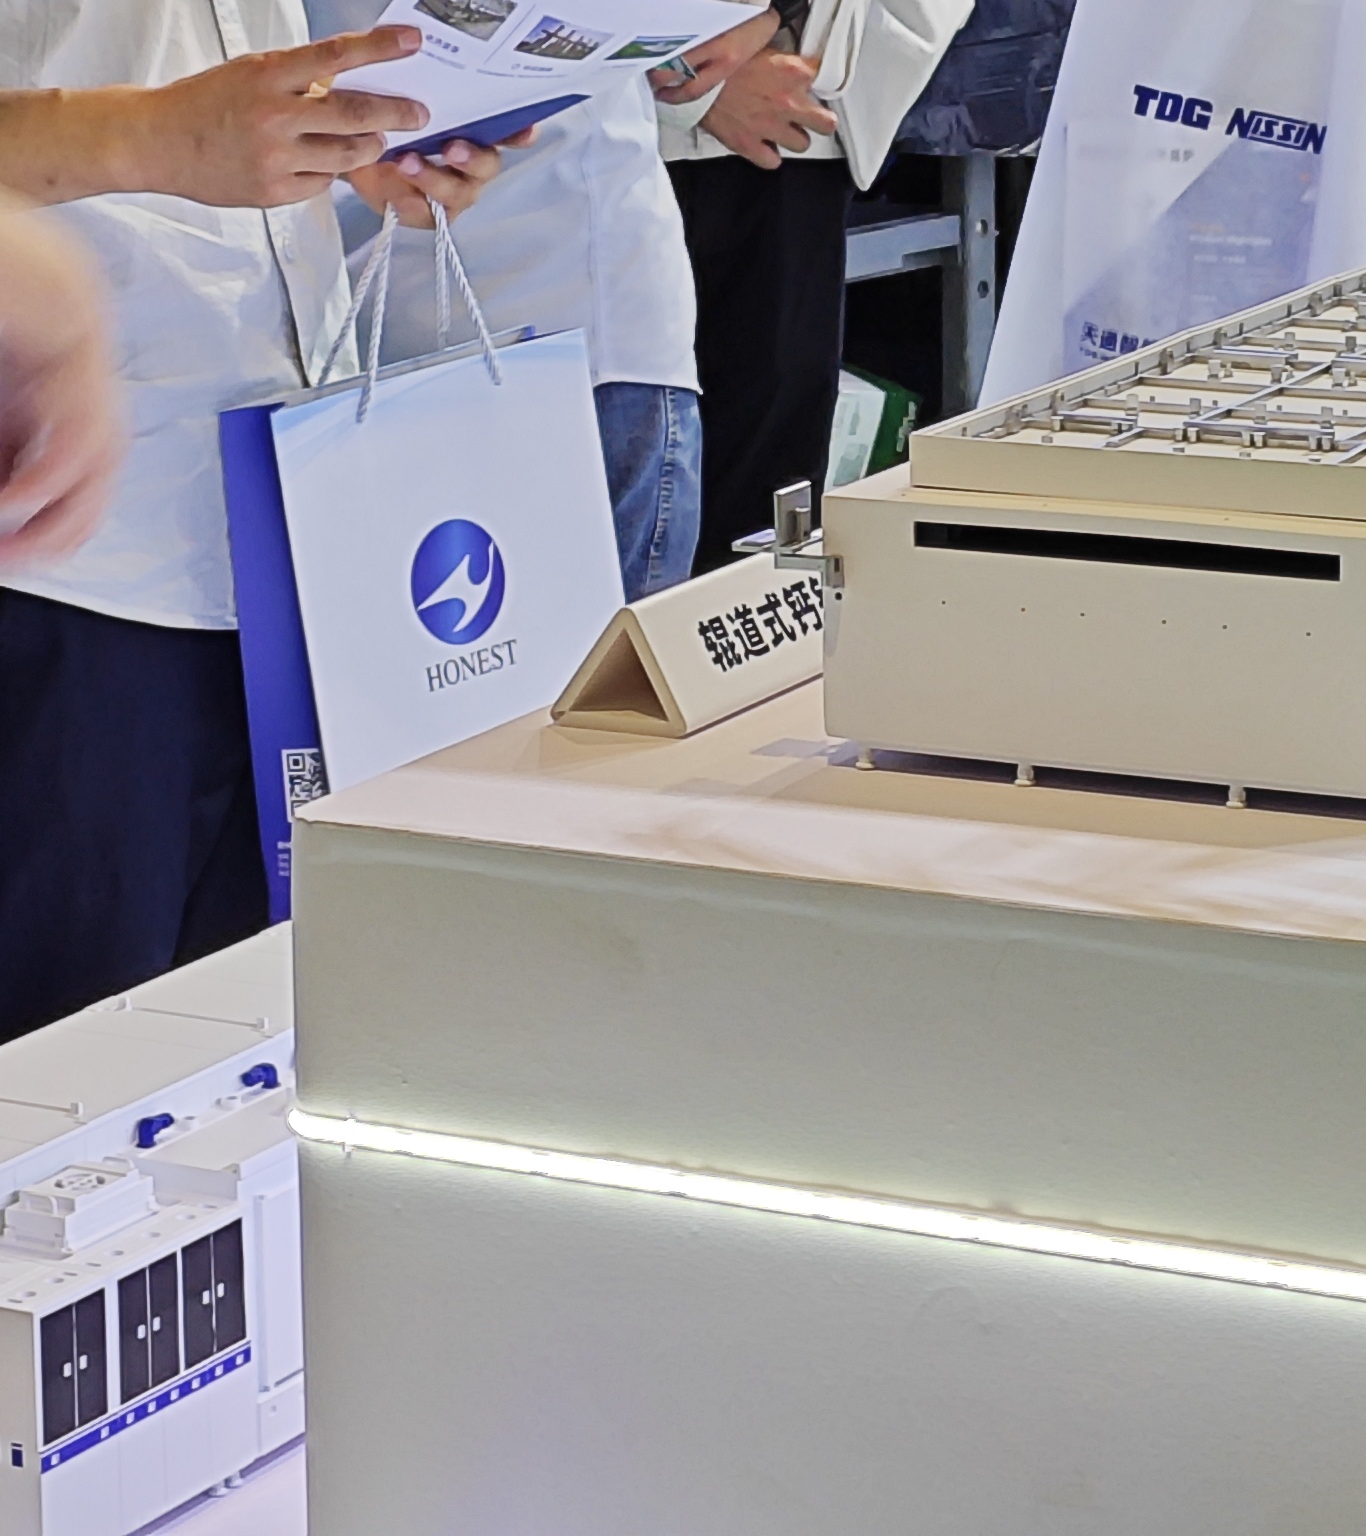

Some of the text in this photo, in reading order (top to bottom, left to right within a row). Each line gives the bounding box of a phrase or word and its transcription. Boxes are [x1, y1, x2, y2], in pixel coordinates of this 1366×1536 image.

[1134, 84, 1327, 155] TDG NISSIN
[425, 639, 517, 692] HONEST
